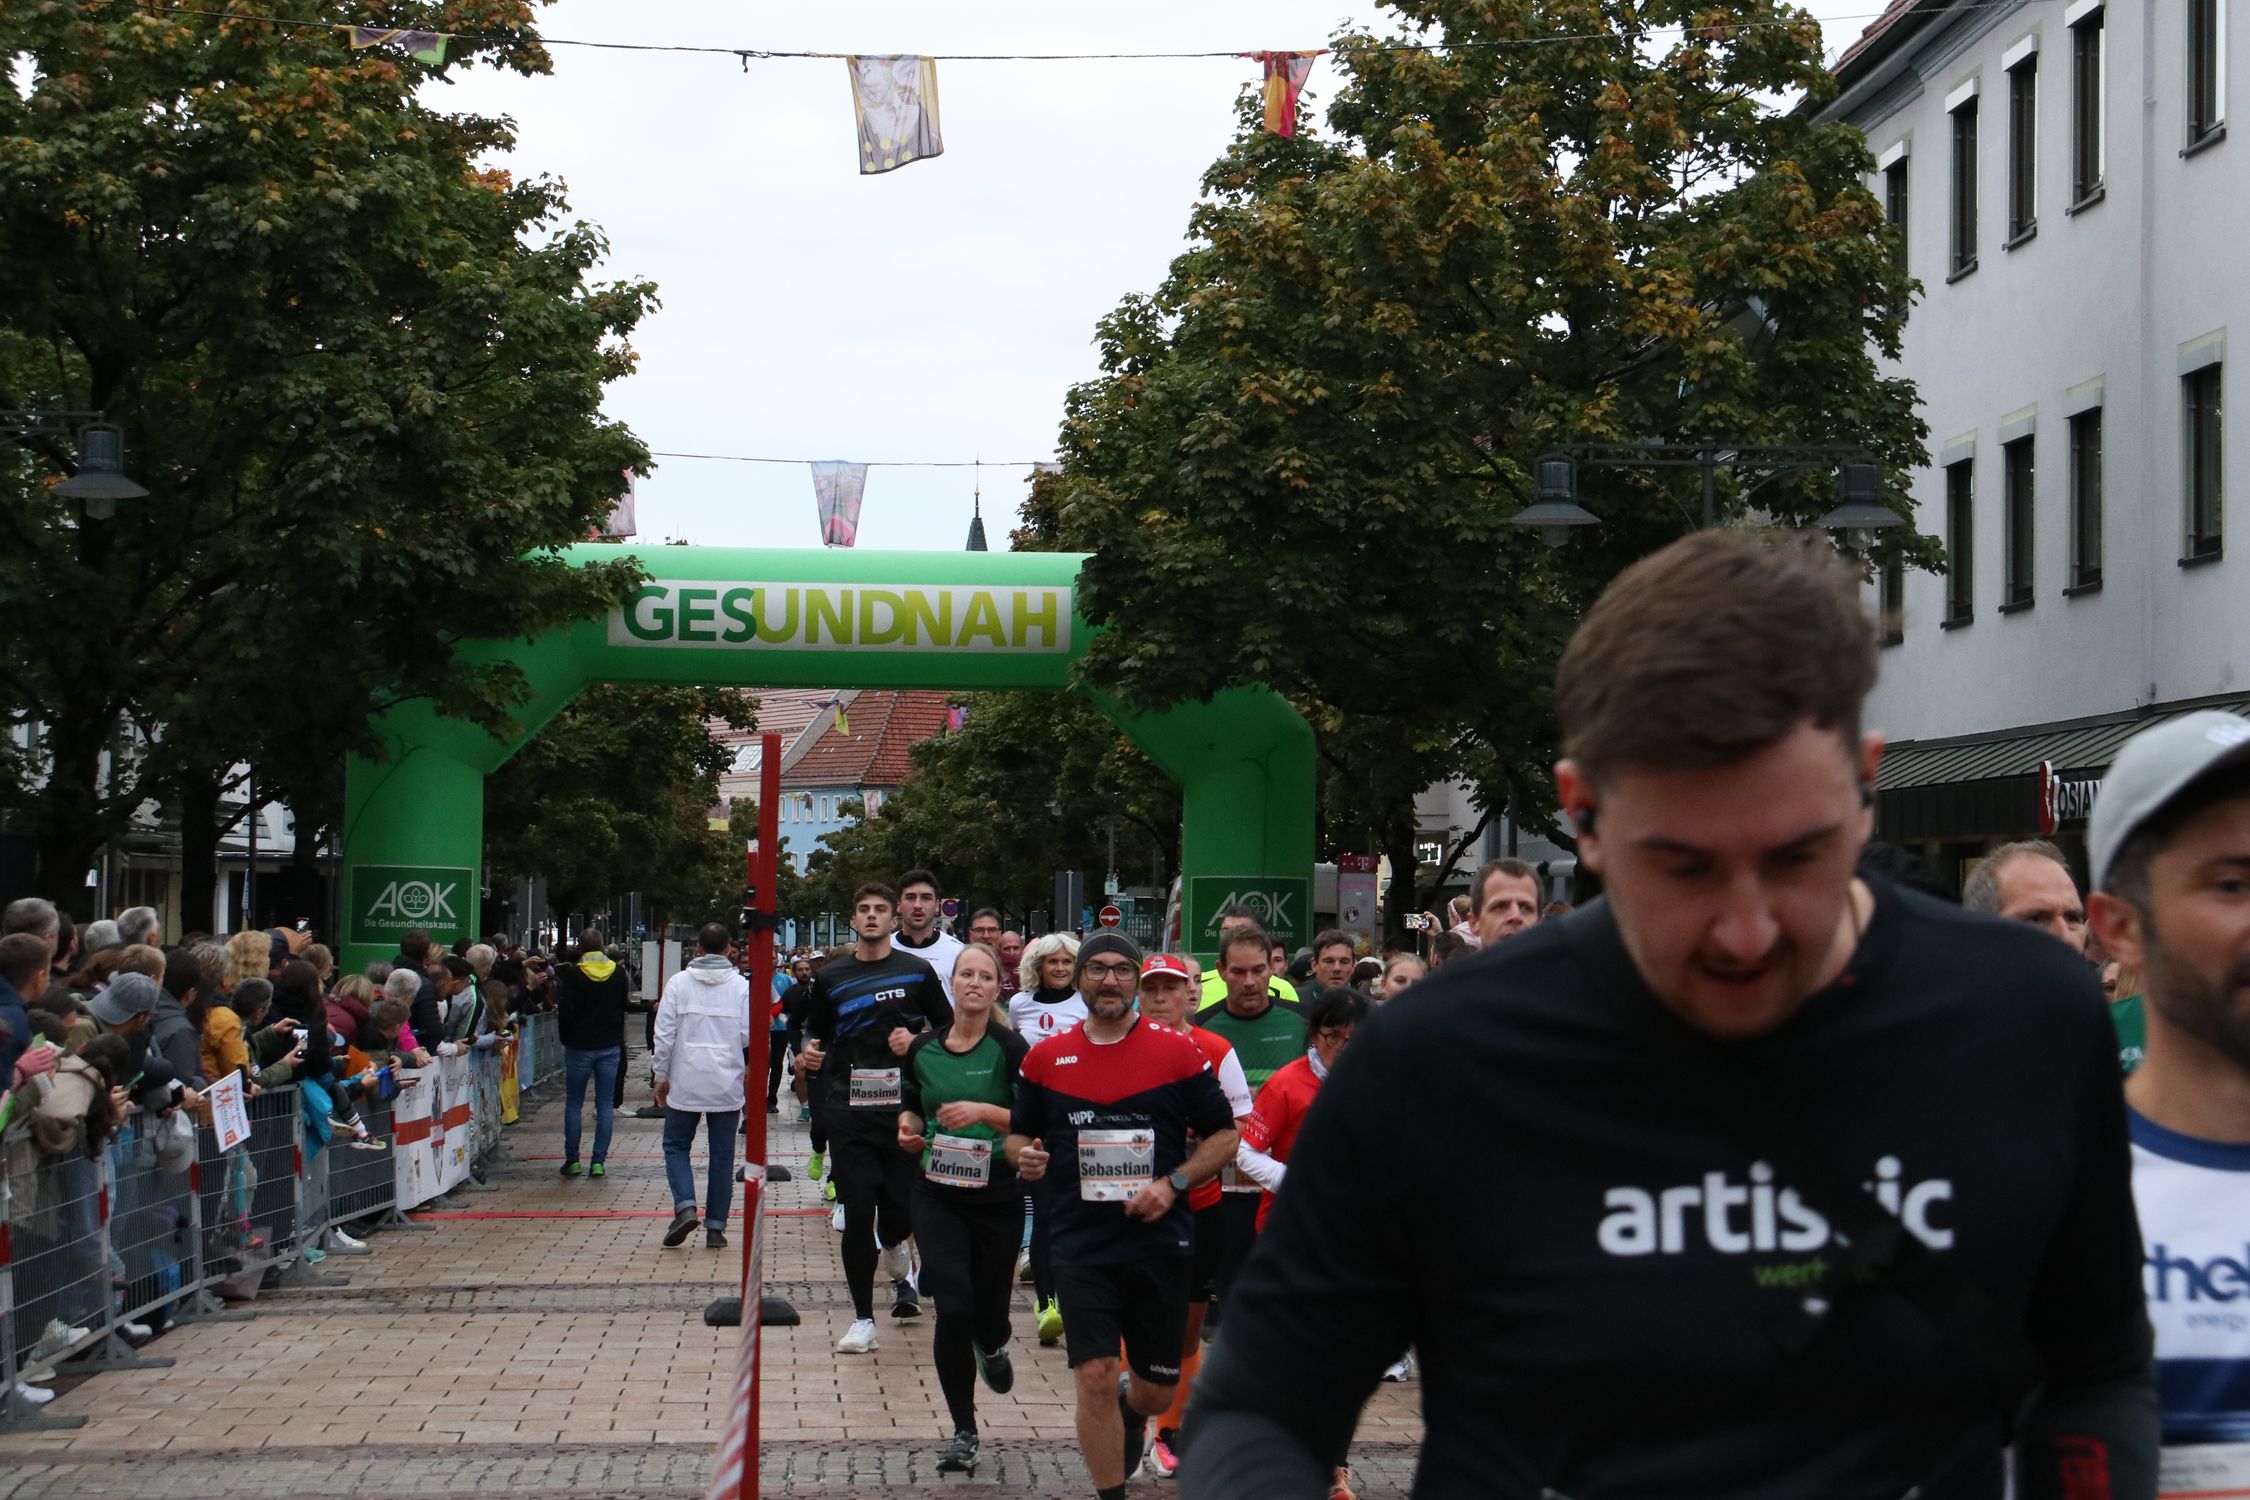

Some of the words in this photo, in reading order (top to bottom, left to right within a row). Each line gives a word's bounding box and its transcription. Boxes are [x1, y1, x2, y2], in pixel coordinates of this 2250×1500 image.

[622, 584, 1058, 648] GESUNDNAH
[367, 881, 457, 918] AOK
[1207, 891, 1293, 927] AOK
[364, 919, 376, 928] Die
[1205, 929, 1217, 937] Die
[875, 988, 906, 1002] CTS
[1055, 1055, 1078, 1066] JAKO
[851, 1088, 898, 1099] Massimo
[1068, 1110, 1095, 1126] HIPP
[931, 1159, 982, 1178] Korinna
[1081, 1161, 1150, 1177] Sebastian
[1598, 1155, 1954, 1255] artisic
